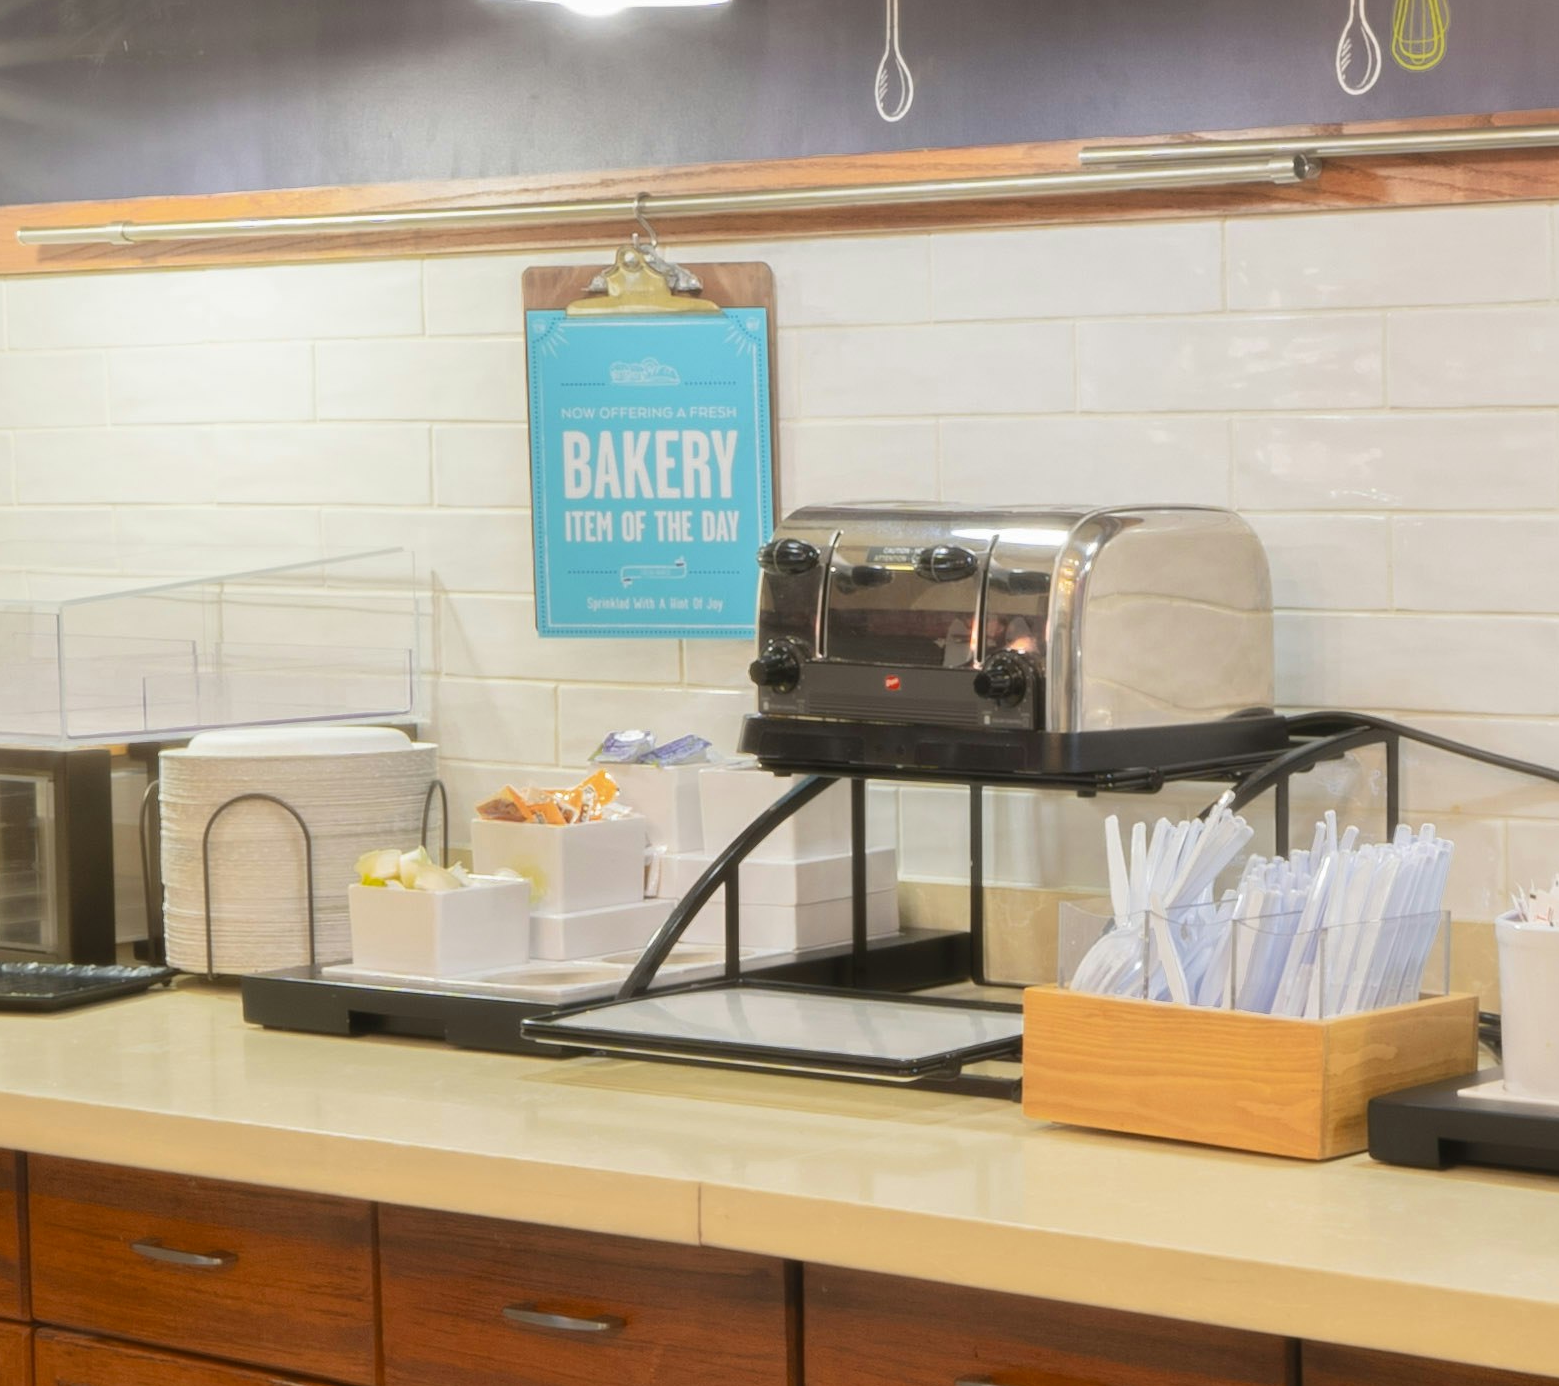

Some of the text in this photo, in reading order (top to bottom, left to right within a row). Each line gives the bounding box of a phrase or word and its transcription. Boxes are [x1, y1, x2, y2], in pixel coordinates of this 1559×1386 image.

[560, 406, 738, 420] NOW OFFERING A FRESH
[562, 430, 739, 500] BAKERY
[565, 510, 740, 543] ITEM OF THE DAY
[586, 596, 724, 613] Sprinkled With A Hint Of Joy
